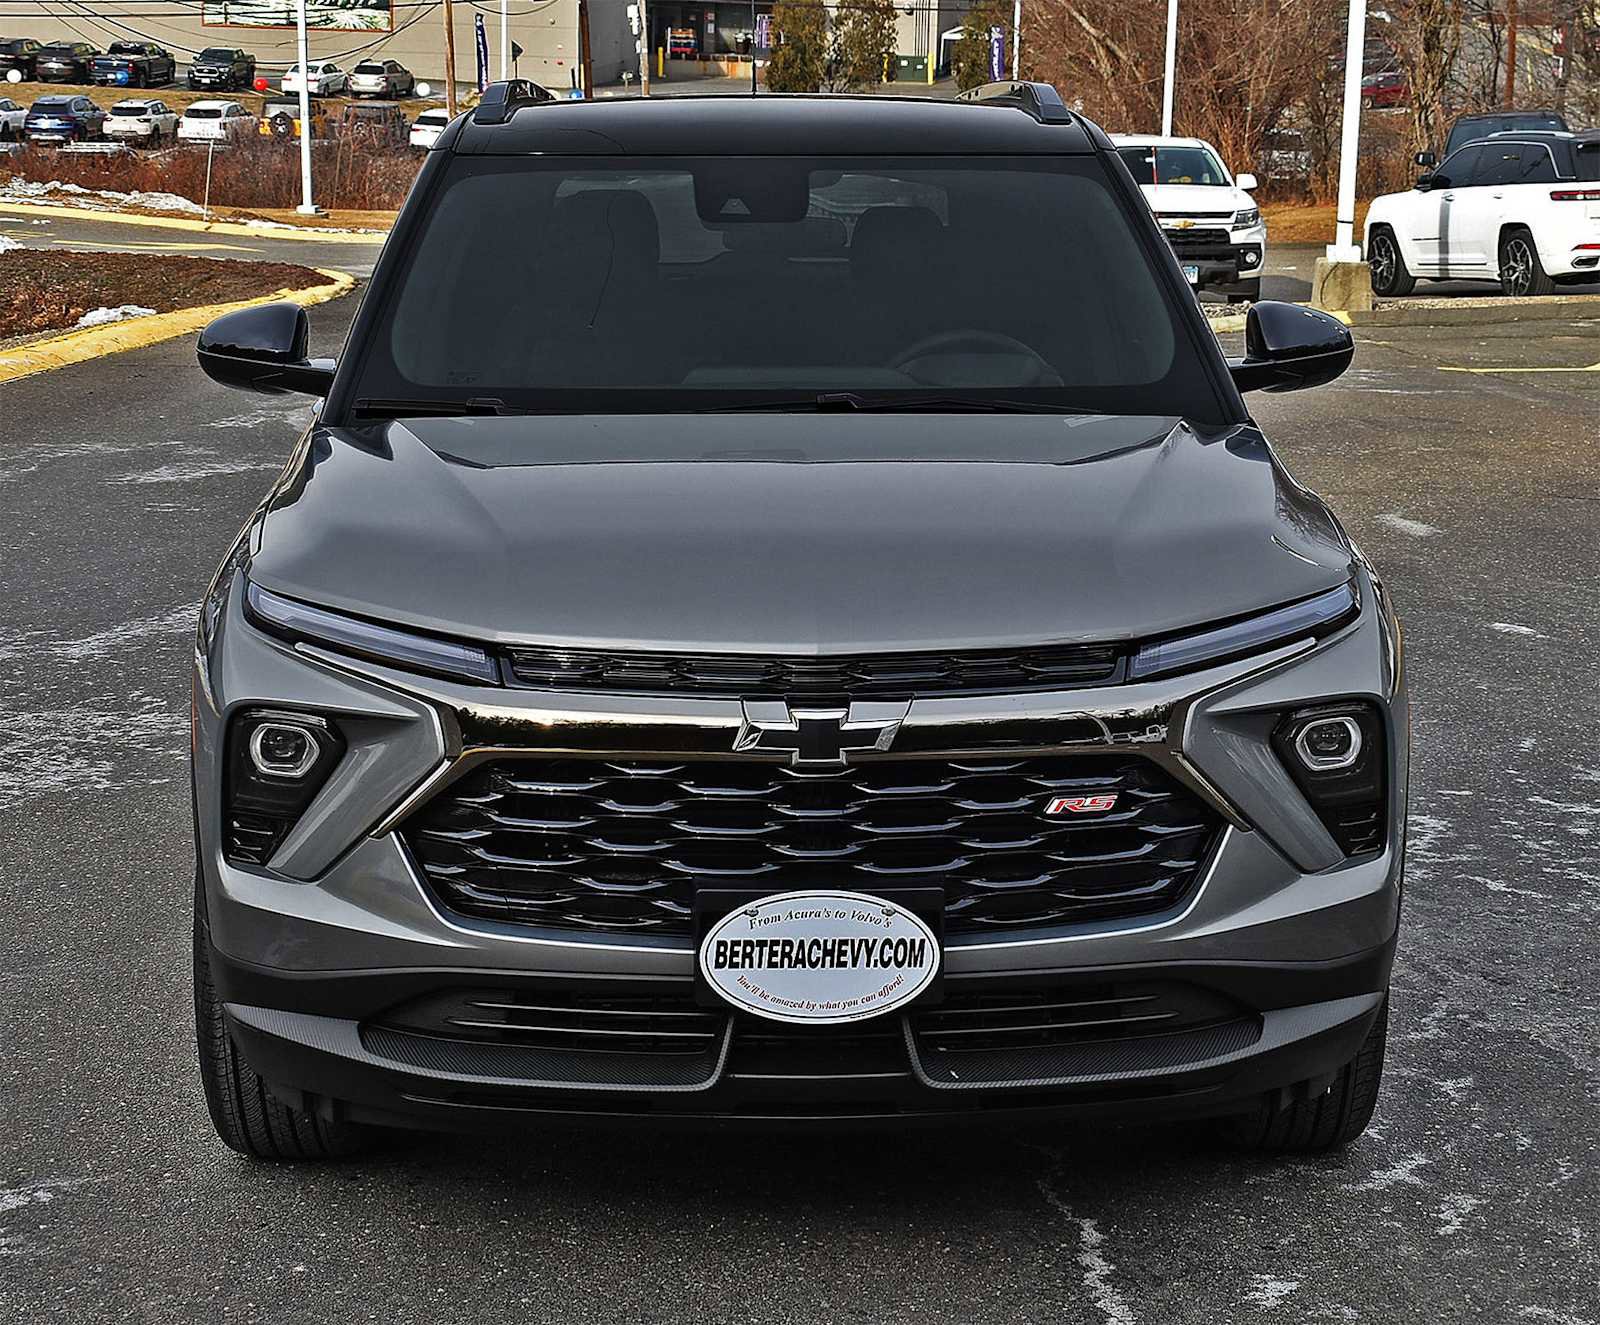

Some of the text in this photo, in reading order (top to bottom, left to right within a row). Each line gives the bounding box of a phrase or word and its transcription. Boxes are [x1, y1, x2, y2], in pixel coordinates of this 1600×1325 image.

[1045, 795, 1118, 814] RS
[748, 908, 893, 930] From Acura's to Volvo's
[714, 938, 926, 969] BERTERACHEVY.COM
[736, 975, 760, 995] You'll
[759, 989, 770, 1001] be
[770, 996, 805, 1009] amazed
[806, 1000, 817, 1012] by
[818, 1000, 841, 1010] what
[841, 1000, 858, 1012] you
[861, 994, 876, 1004] can
[878, 973, 905, 998] afford!
